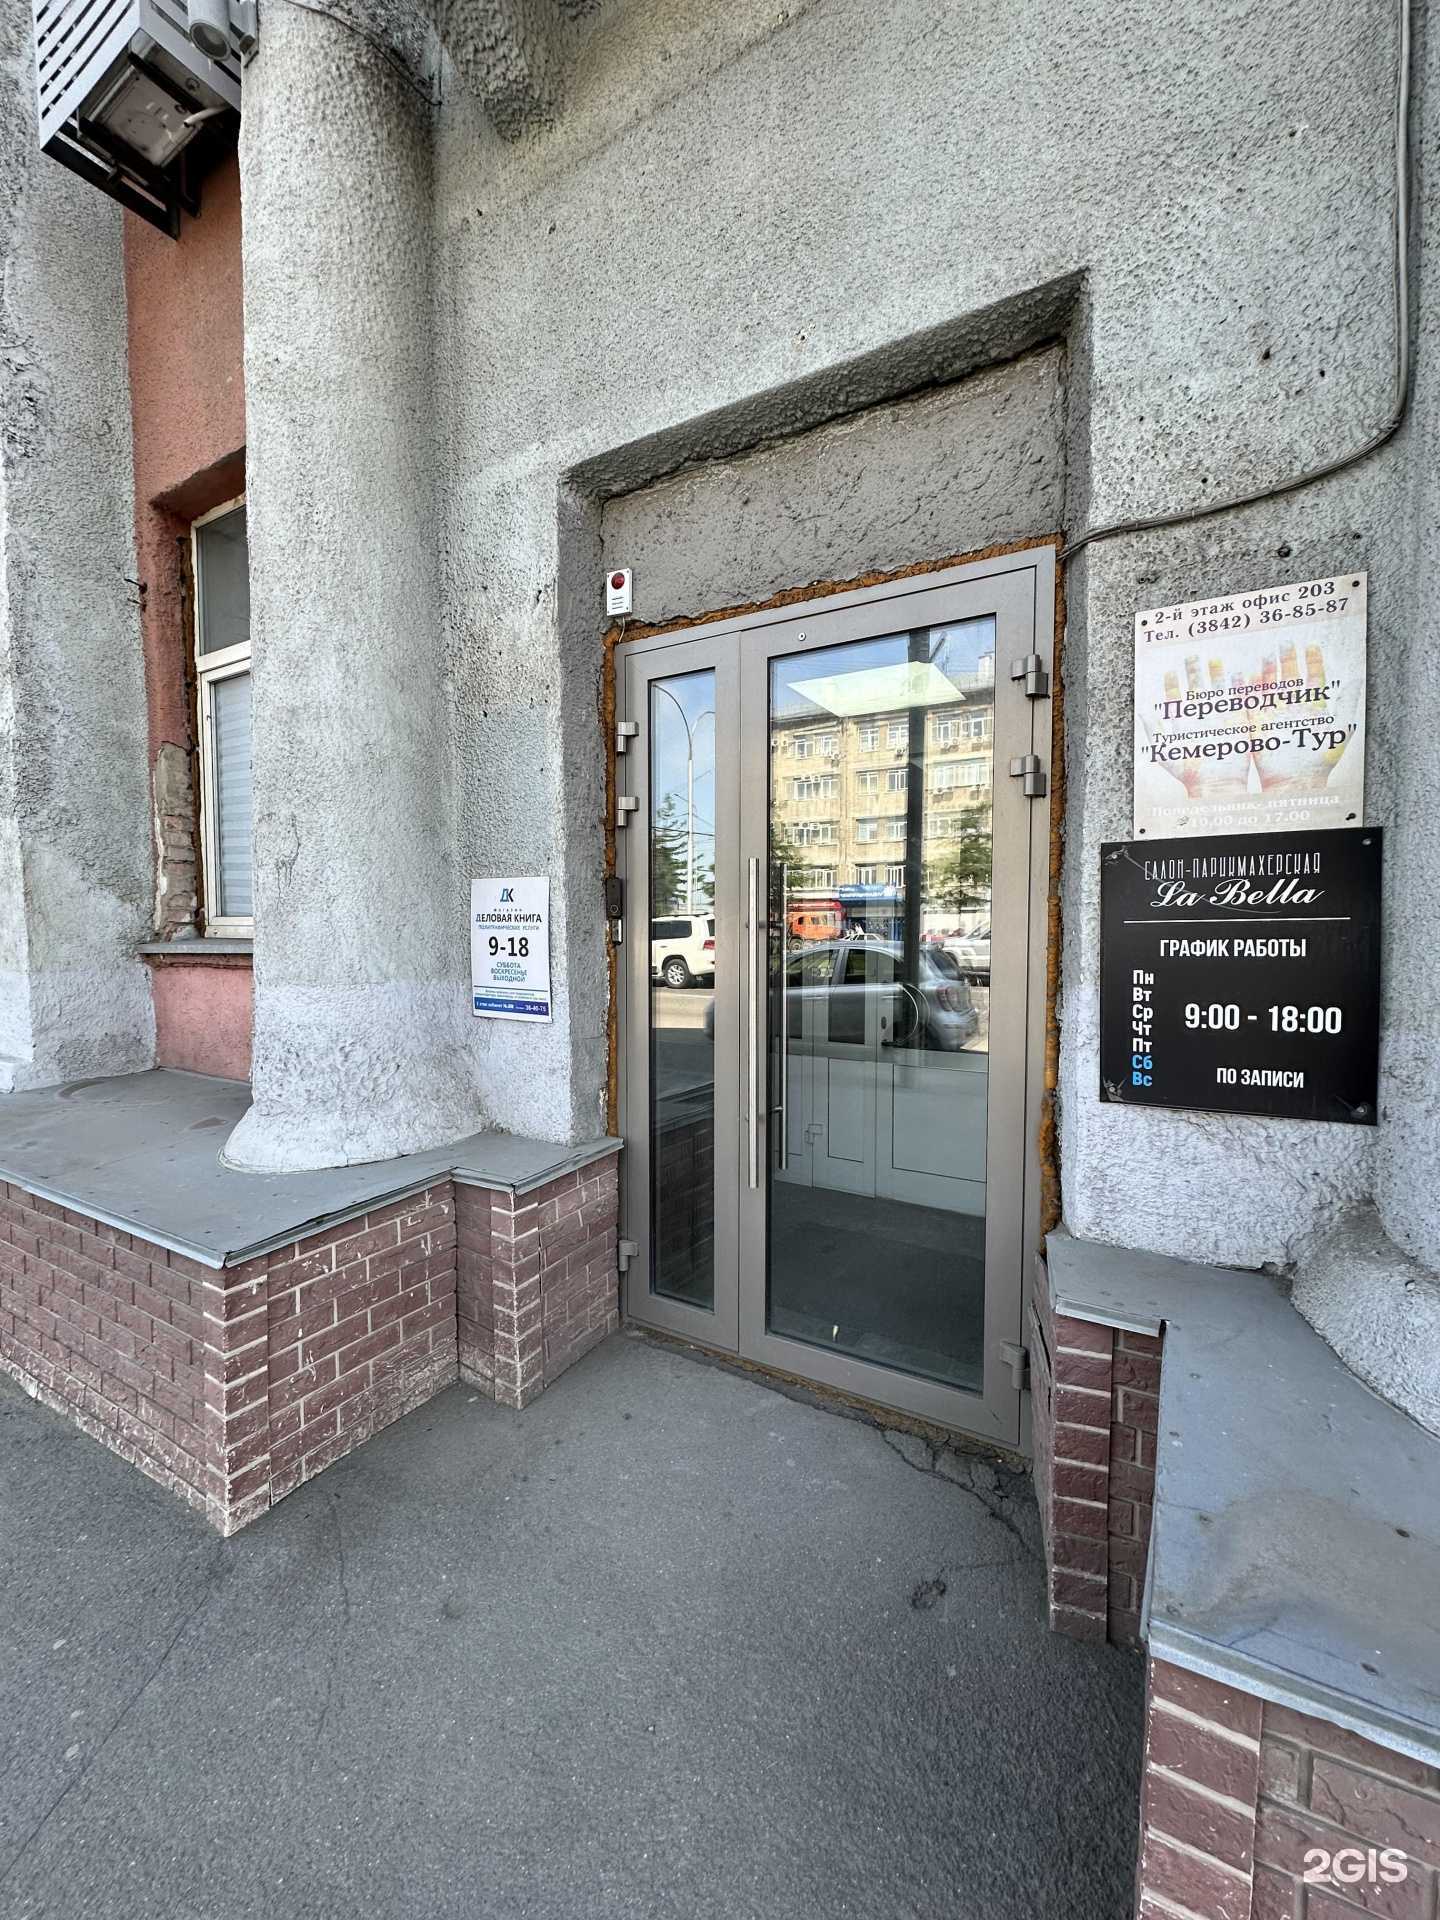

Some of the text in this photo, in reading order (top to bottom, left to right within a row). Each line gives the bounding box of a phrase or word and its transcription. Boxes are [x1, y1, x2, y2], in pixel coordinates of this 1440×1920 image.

[1155, 581, 1336, 624] 2-й этаж офис 203
[1143, 597, 1350, 643] Тел. (3842) 36-85-87
[1186, 678, 1304, 701] Бюро переводов
[1154, 680, 1341, 720] "Переводчик"
[1152, 715, 1335, 745] Туристическое агентство
[1141, 723, 1358, 762] "Кемерово-Тур"
[1144, 852, 1321, 881] САЛОН-ПАРИКМАХЕРСКАЯ
[1150, 878, 1326, 908] La Bella
[475, 913, 542, 923] ДЕЛОВАЯ КНИГА
[488, 935, 529, 957] 9-18
[1160, 938, 1307, 957] ГРАФИК РАБОТЫ
[490, 967, 528, 976] ВОСКРЕСЕНЬЕ
[496, 961, 521, 969] СУББОТА
[492, 974, 526, 982] ВЫХОДНОЙ
[1132, 969, 1154, 985] Пн
[1132, 986, 1152, 1002] Вт
[1132, 1003, 1153, 1022] Ср
[1184, 1003, 1240, 1031] 9:00
[1268, 1005, 1343, 1034] 18:00
[1132, 1020, 1153, 1036] Чт
[1132, 1037, 1153, 1052] Пт
[1131, 1054, 1153, 1070] Сб
[1131, 1071, 1153, 1087] Вс
[1216, 1067, 1305, 1088] ПО ЗАПИСИ
